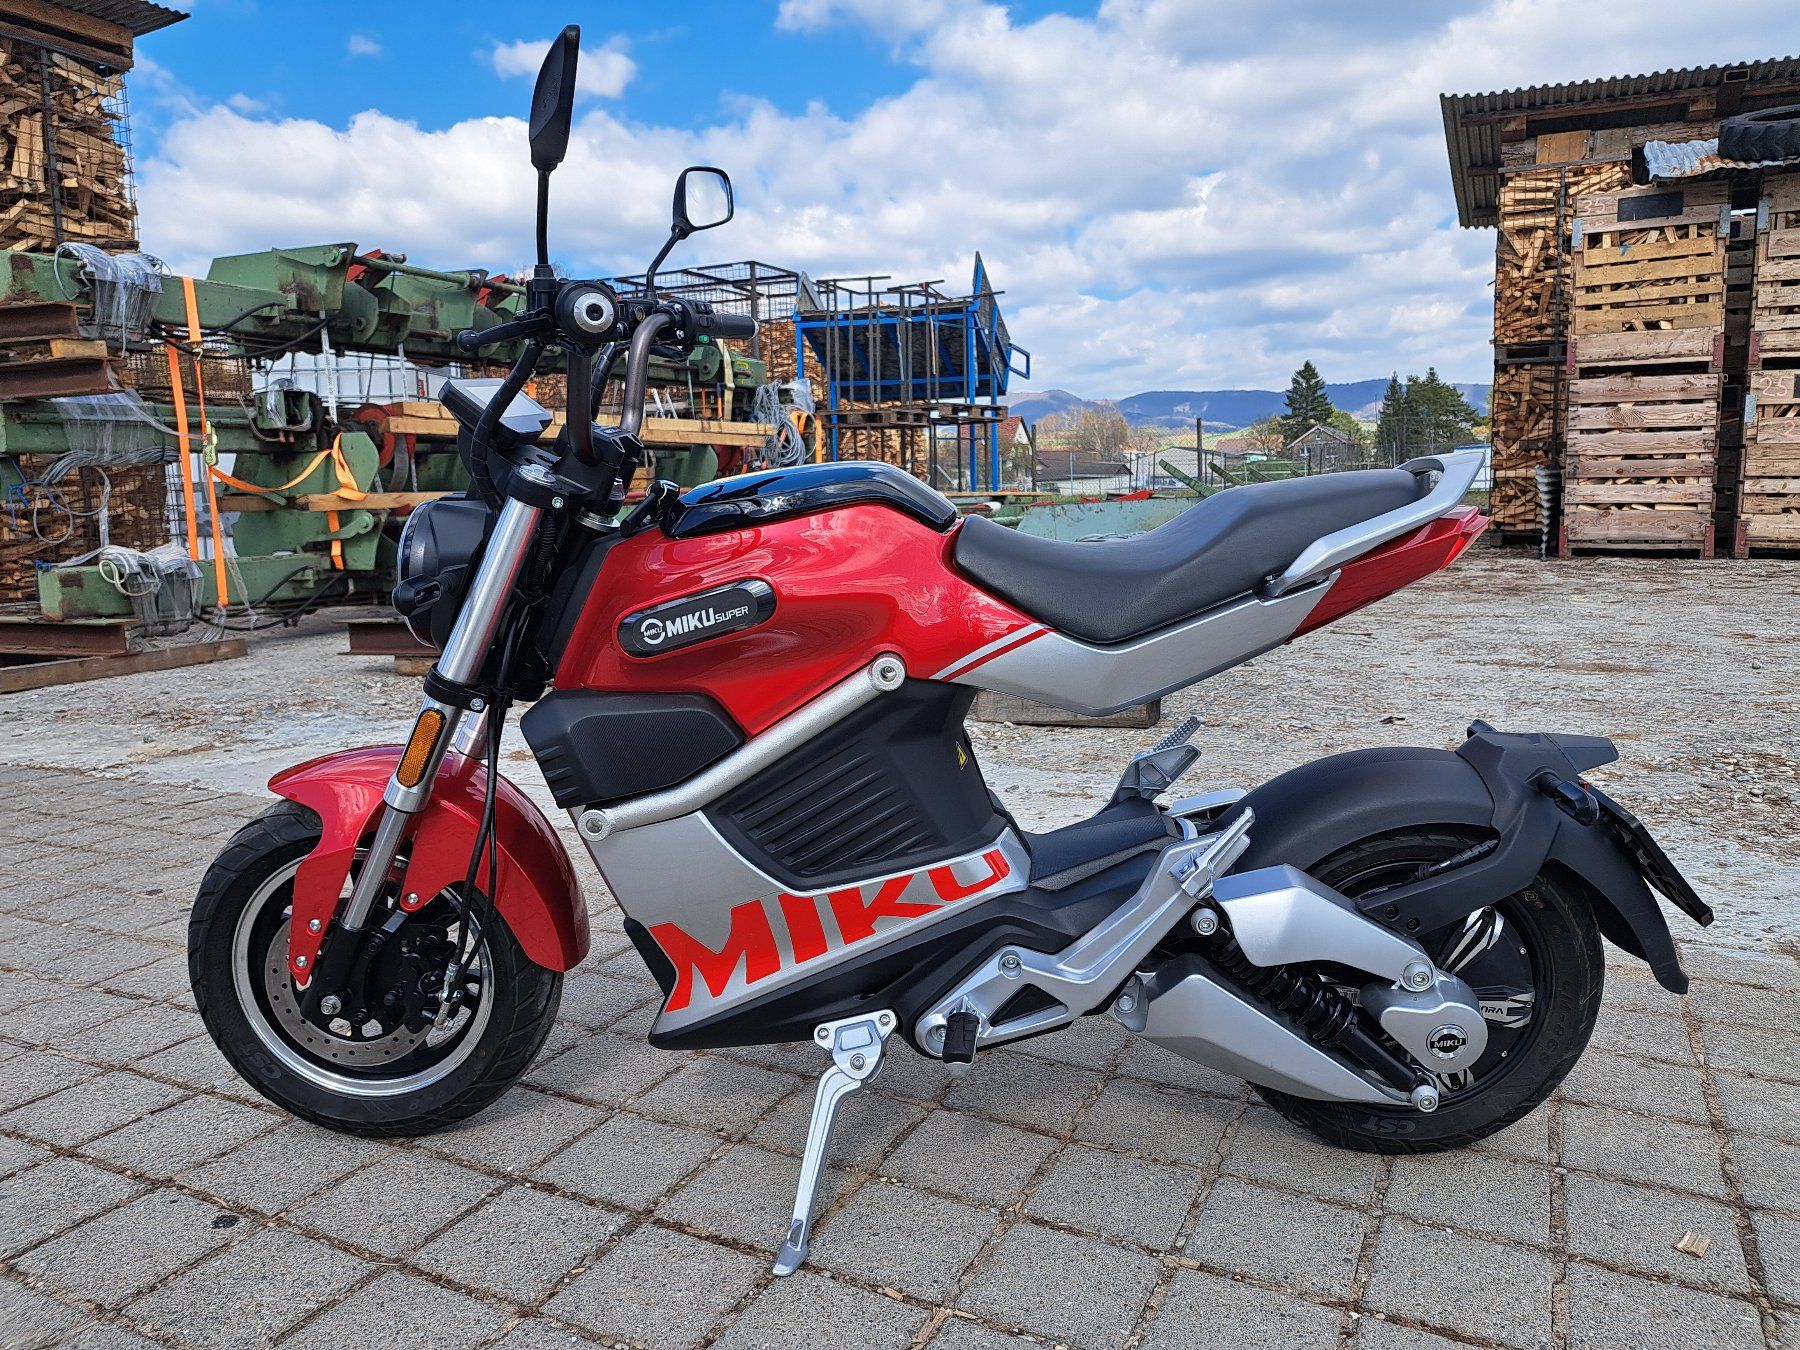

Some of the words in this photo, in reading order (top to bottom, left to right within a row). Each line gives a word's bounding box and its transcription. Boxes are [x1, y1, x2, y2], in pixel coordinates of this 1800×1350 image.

[1759, 376, 1794, 397] 25
[643, 626, 663, 637] MIKU
[665, 607, 716, 638] MIKU
[715, 605, 749, 624] SUPER
[648, 849, 1011, 1013] MIKU
[1434, 1038, 1463, 1048] MIKU
[238, 1042, 282, 1079] CST
[1361, 1116, 1416, 1134] CST
